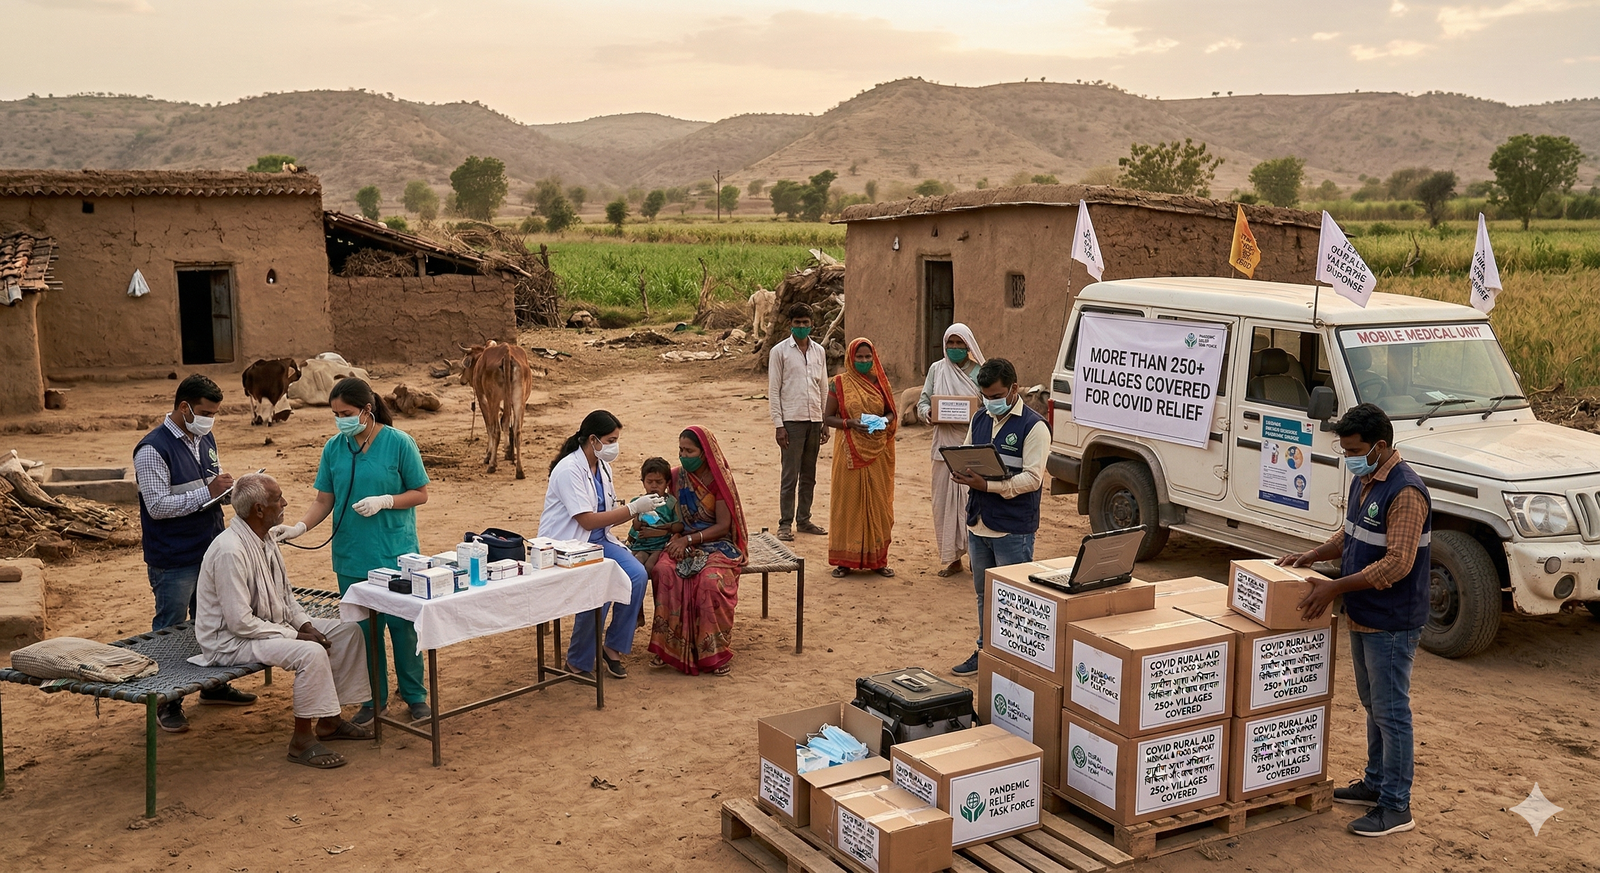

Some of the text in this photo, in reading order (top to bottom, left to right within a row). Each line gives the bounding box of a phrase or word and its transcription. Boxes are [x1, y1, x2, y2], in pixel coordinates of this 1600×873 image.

[1357, 326, 1482, 344] MOBILE MEDICAL UNIT
[1090, 347, 1205, 375] MORE THAN 250+
[1083, 366, 1211, 400] VILLAGES COVERED
[1085, 388, 1204, 421] FOR COVID RELIEF
[1039, 603, 1051, 614] AID
[1261, 633, 1325, 652] COVID RURAL AID
[1150, 650, 1220, 671] COVID RURAL AID
[1264, 673, 1318, 691] 250+ VILLAGES
[1155, 692, 1213, 711] 250+ VILLAGES
[1274, 685, 1308, 699] COVERED
[1165, 704, 1202, 719] COVERED
[1253, 714, 1318, 736] COVID RURAL AID
[1146, 734, 1215, 756] COVID RURAL AID
[1257, 754, 1310, 773] 250+ VILLAGES
[1266, 766, 1300, 781] COVERED
[989, 779, 1030, 796] PANDEMIC
[1150, 775, 1208, 796] 250+ VILLAGES
[1161, 787, 1197, 803] COVERED
[989, 793, 1016, 807] RELIEF
[989, 798, 1035, 818] TASK FORCE
